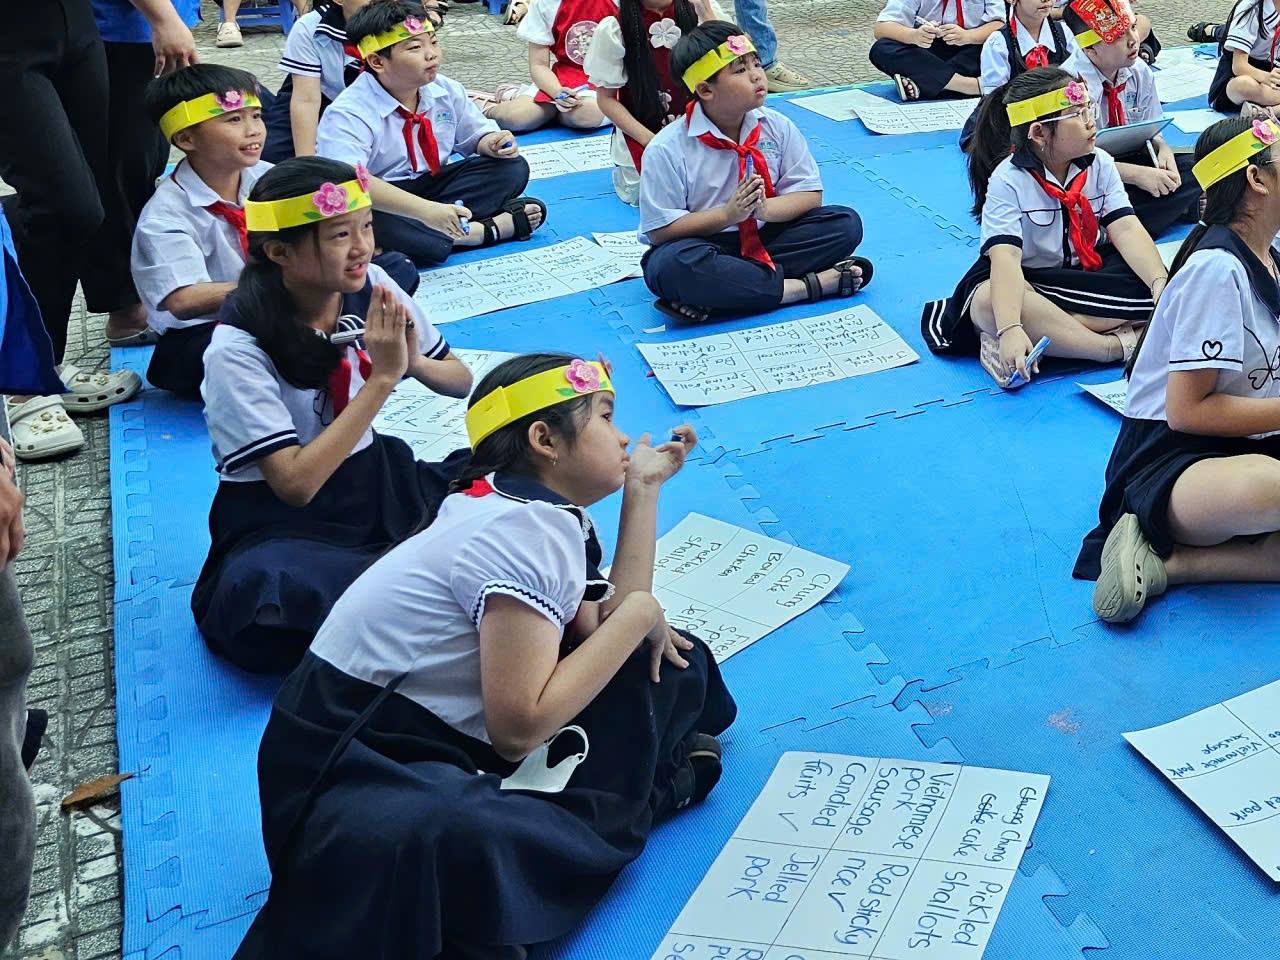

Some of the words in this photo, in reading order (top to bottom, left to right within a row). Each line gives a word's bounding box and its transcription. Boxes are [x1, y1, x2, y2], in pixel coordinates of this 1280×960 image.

[775, 573, 831, 608] Chung
[1166, 762, 1195, 778] pork
[1230, 800, 1264, 822] pork
[762, 852, 820, 904] Jellied
[831, 857, 866, 887] rice
[867, 862, 910, 897] Red
